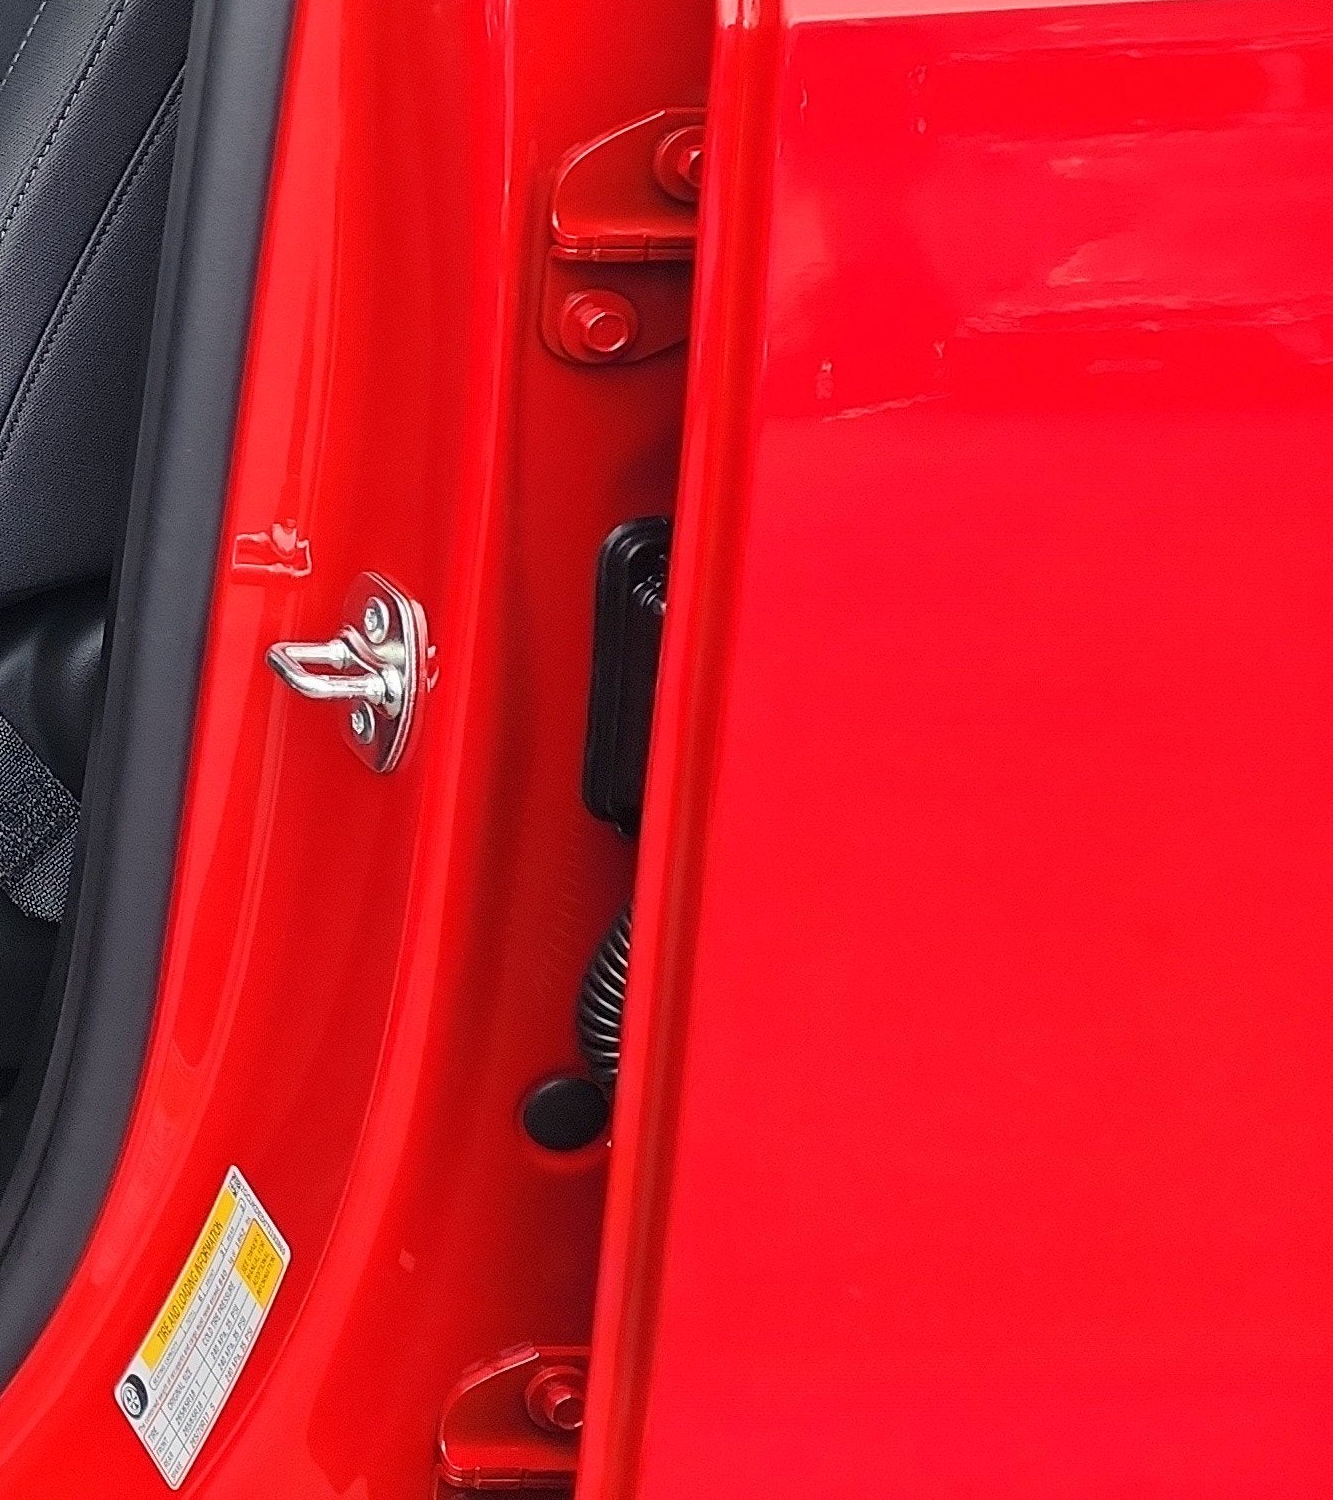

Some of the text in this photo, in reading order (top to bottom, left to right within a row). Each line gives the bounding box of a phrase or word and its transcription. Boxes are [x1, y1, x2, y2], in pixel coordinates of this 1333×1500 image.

[156, 1320, 171, 1343] TIRE
[176, 1270, 198, 1310] LOADING
[194, 1221, 222, 1274] INFORMATION
